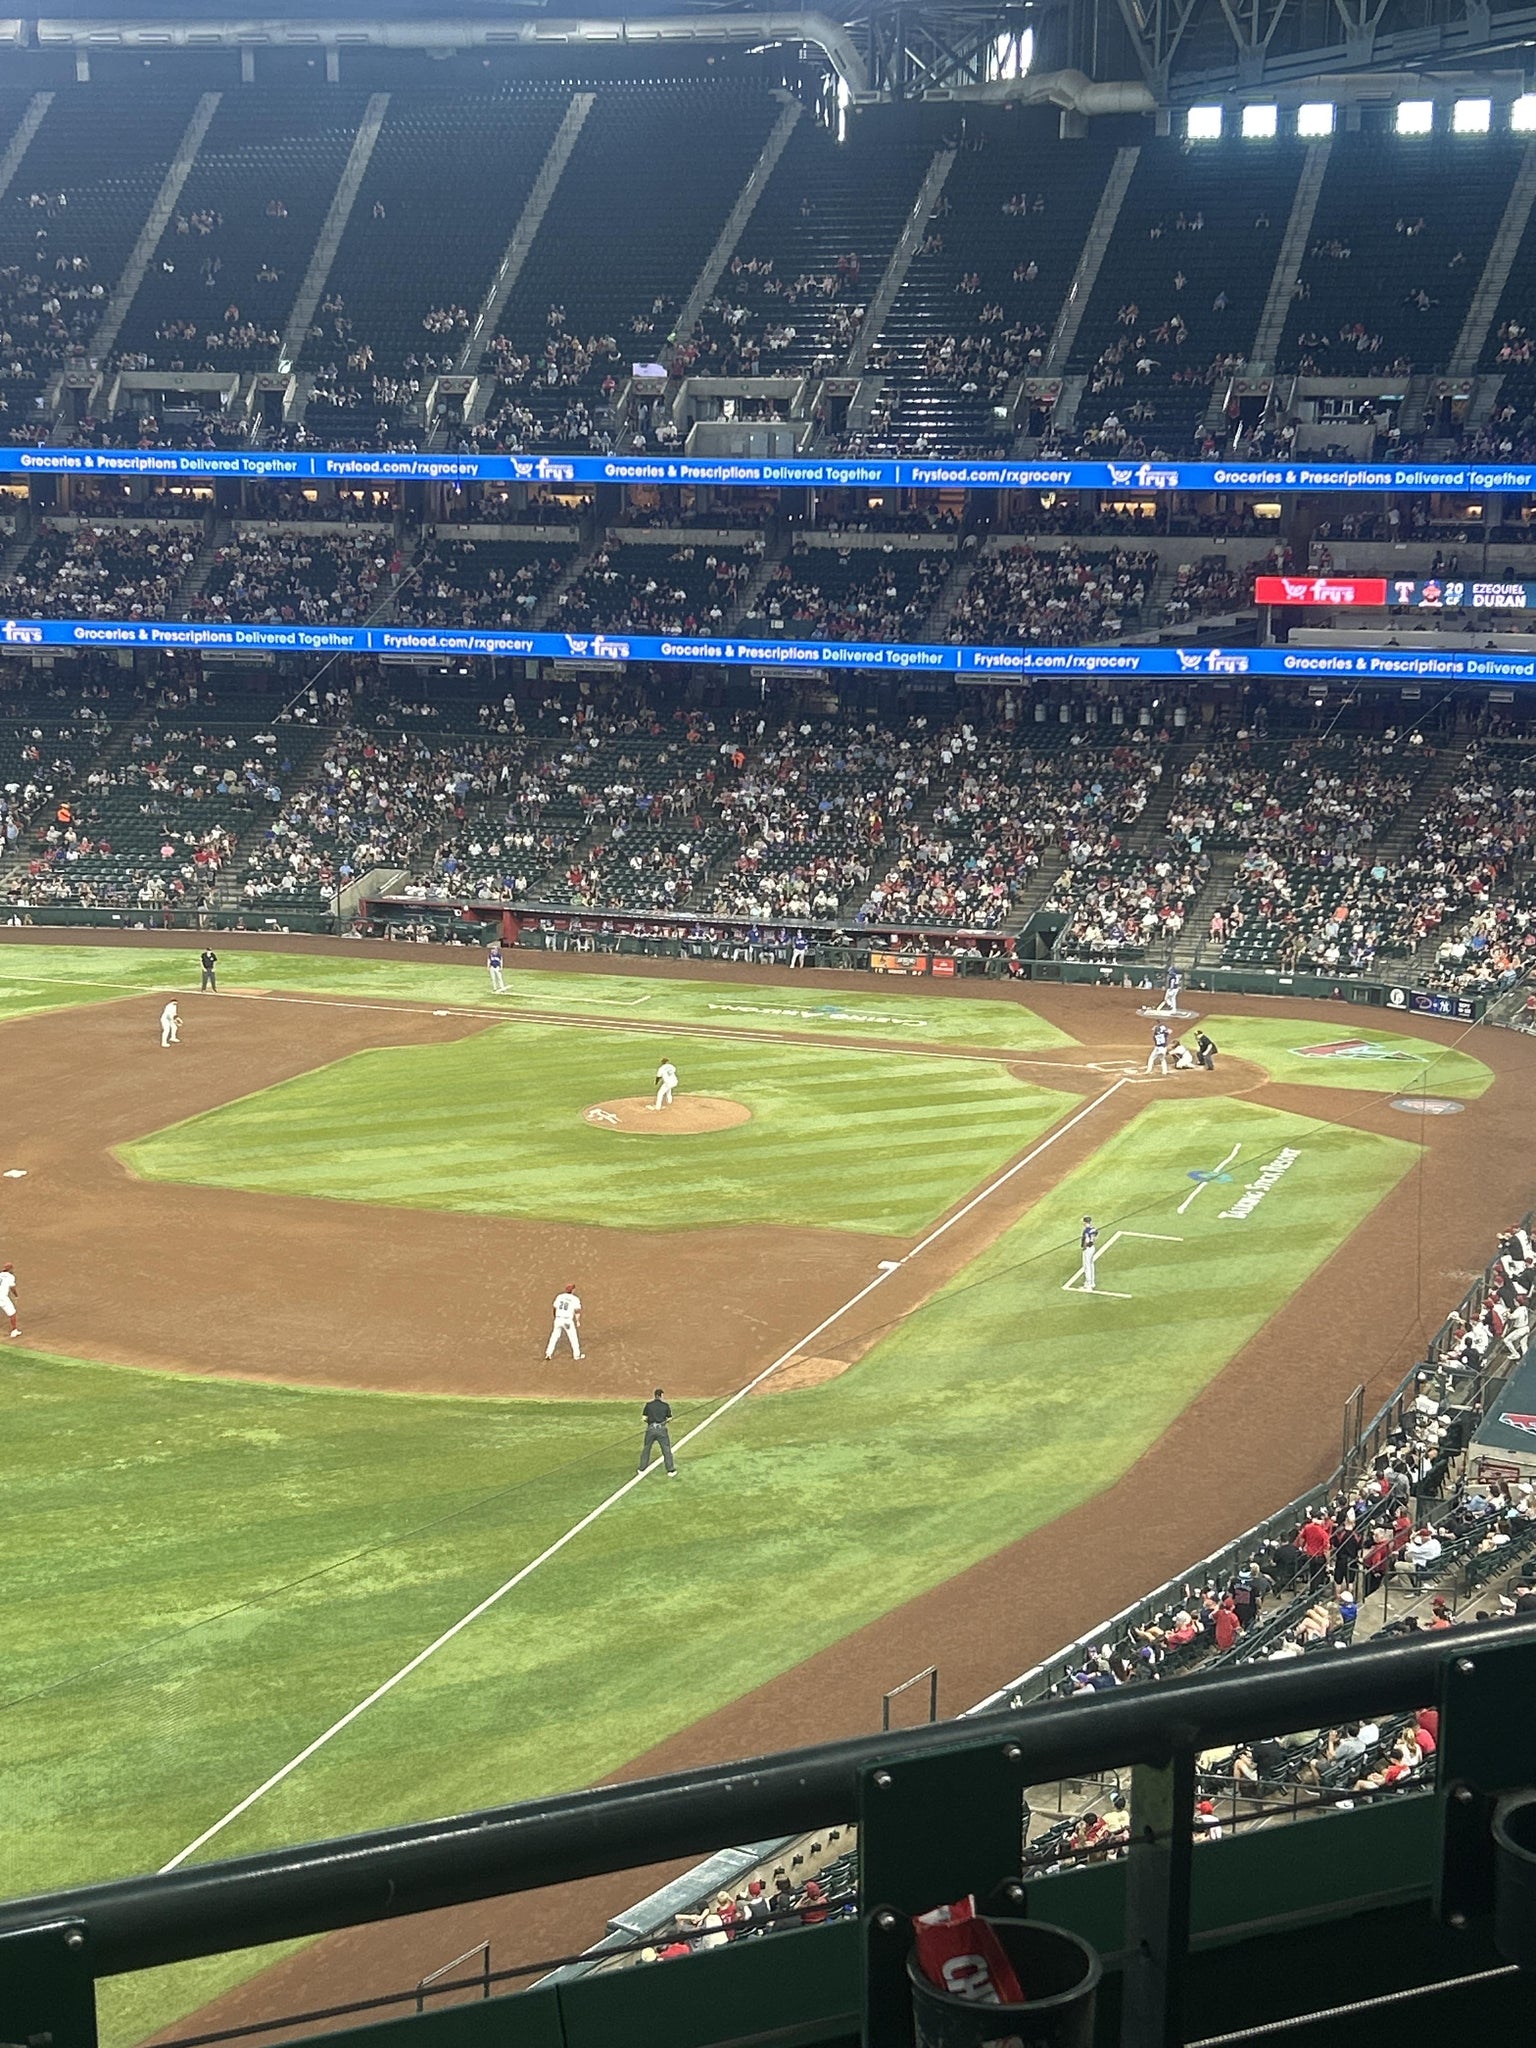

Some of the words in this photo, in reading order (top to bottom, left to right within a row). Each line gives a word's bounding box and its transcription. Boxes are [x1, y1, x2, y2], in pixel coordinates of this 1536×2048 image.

[21, 455, 81, 467] Groceries
[85, 456, 93, 467] &
[97, 456, 177, 471] Prescriptions
[181, 458, 239, 470] Delivered
[242, 459, 296, 473] Together
[327, 460, 478, 476] Frysfood.com/rxgrocery
[535, 457, 574, 479] fry's
[605, 464, 664, 477] Groceries
[668, 465, 677, 477] &
[681, 466, 760, 480] Prescriptions
[764, 467, 822, 479] Delivered
[826, 468, 881, 482] Together
[913, 468, 1071, 484] Frysfood.com/rxgrocery
[1135, 463, 1178, 486] fry's
[1214, 470, 1282, 483] Groceries
[1286, 471, 1296, 483] &
[1301, 471, 1392, 486] Prescriptions
[1396, 472, 1463, 484] Delivered
[1467, 472, 1531, 487] Together
[1310, 579, 1355, 604] fry's
[1445, 582, 1464, 594] 20
[1473, 583, 1525, 595] EZEQUIEL
[1473, 595, 1526, 608] DURAN
[2, 618, 42, 639] fry's
[74, 627, 135, 640] Groceries
[139, 629, 148, 640] &
[152, 629, 232, 643] Prescriptions
[236, 632, 295, 643] Delivered
[298, 633, 353, 647] Together
[384, 634, 533, 652] Frysfood.com/rxgrocery
[590, 636, 629, 657] fry's
[662, 643, 722, 656] Groceries
[725, 645, 734, 657] &
[738, 646, 819, 660] Prescriptions
[823, 649, 883, 661] Delivered
[886, 651, 942, 663] Together
[975, 653, 1139, 669] Frysfood.com/rxgrocery
[1204, 650, 1248, 672] fry's
[1284, 656, 1352, 669] Groceries
[1356, 658, 1366, 670] &
[1371, 658, 1463, 673] Prescriptions
[1468, 661, 1534, 675] Delivered
